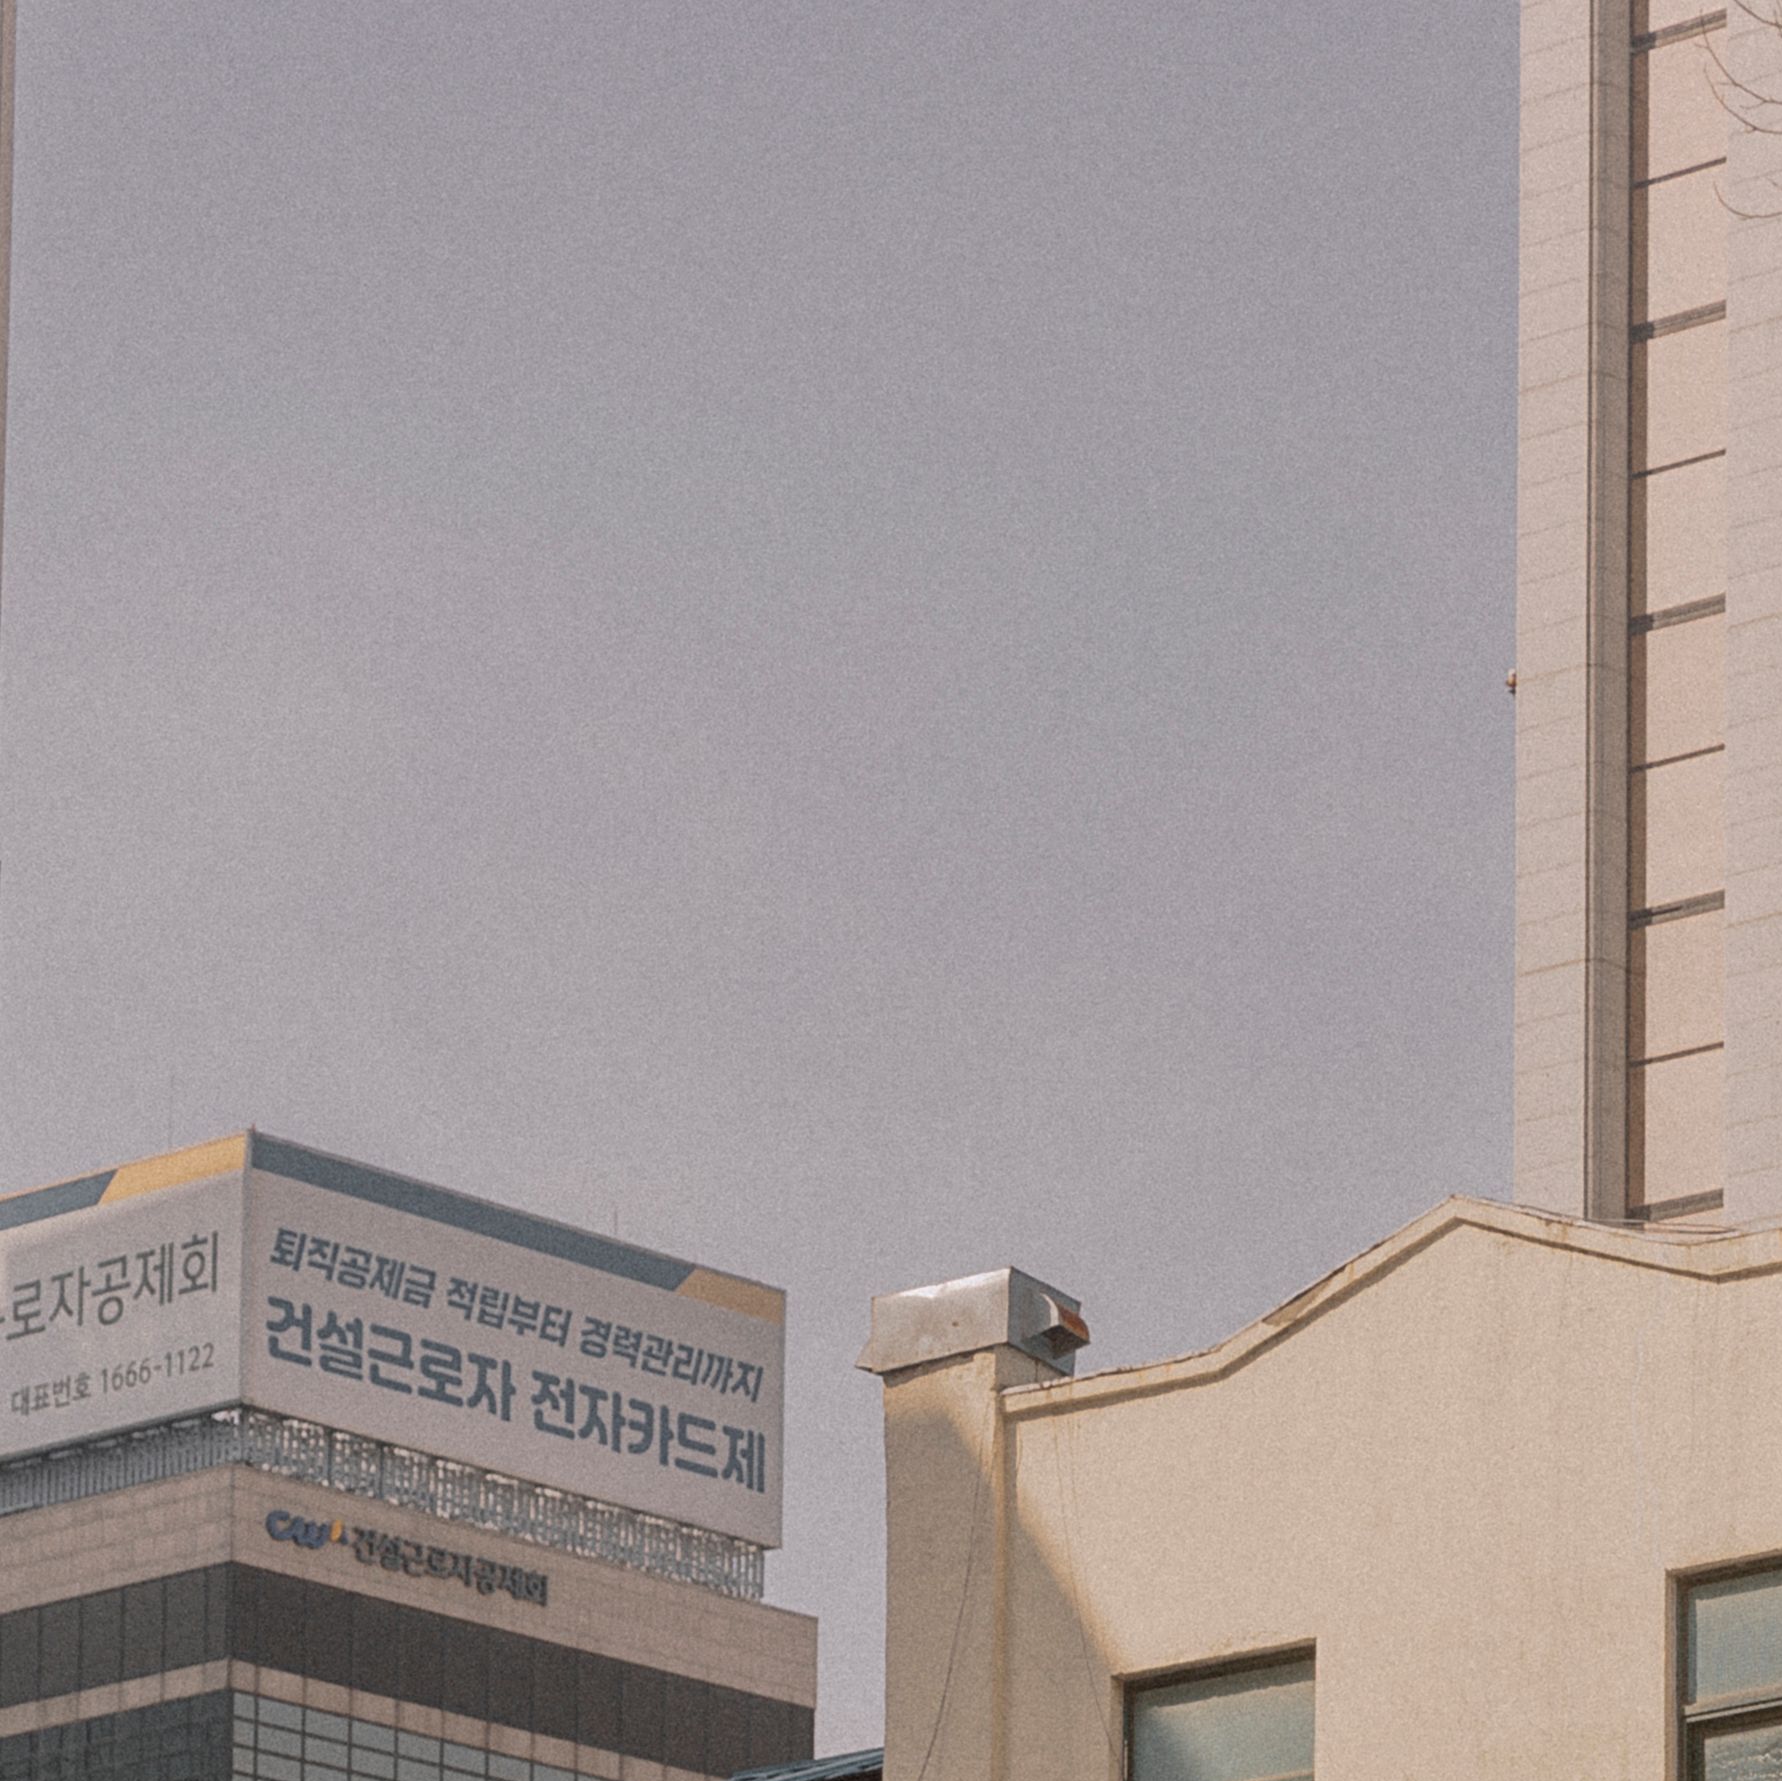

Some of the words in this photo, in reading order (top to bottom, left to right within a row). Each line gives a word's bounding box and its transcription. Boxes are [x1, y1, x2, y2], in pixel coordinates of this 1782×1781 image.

[0, 1230, 218, 1340] 로자공제회
[270, 1228, 436, 1308] 퇴직공제금
[446, 1275, 571, 1348] 적립부터
[579, 1315, 764, 1403] 경력관리까지
[11, 1372, 91, 1415] 대표번호
[100, 1343, 215, 1393] 1666-1122
[266, 1296, 516, 1422] 건설근로자
[531, 1370, 766, 1493] 전자카드제
